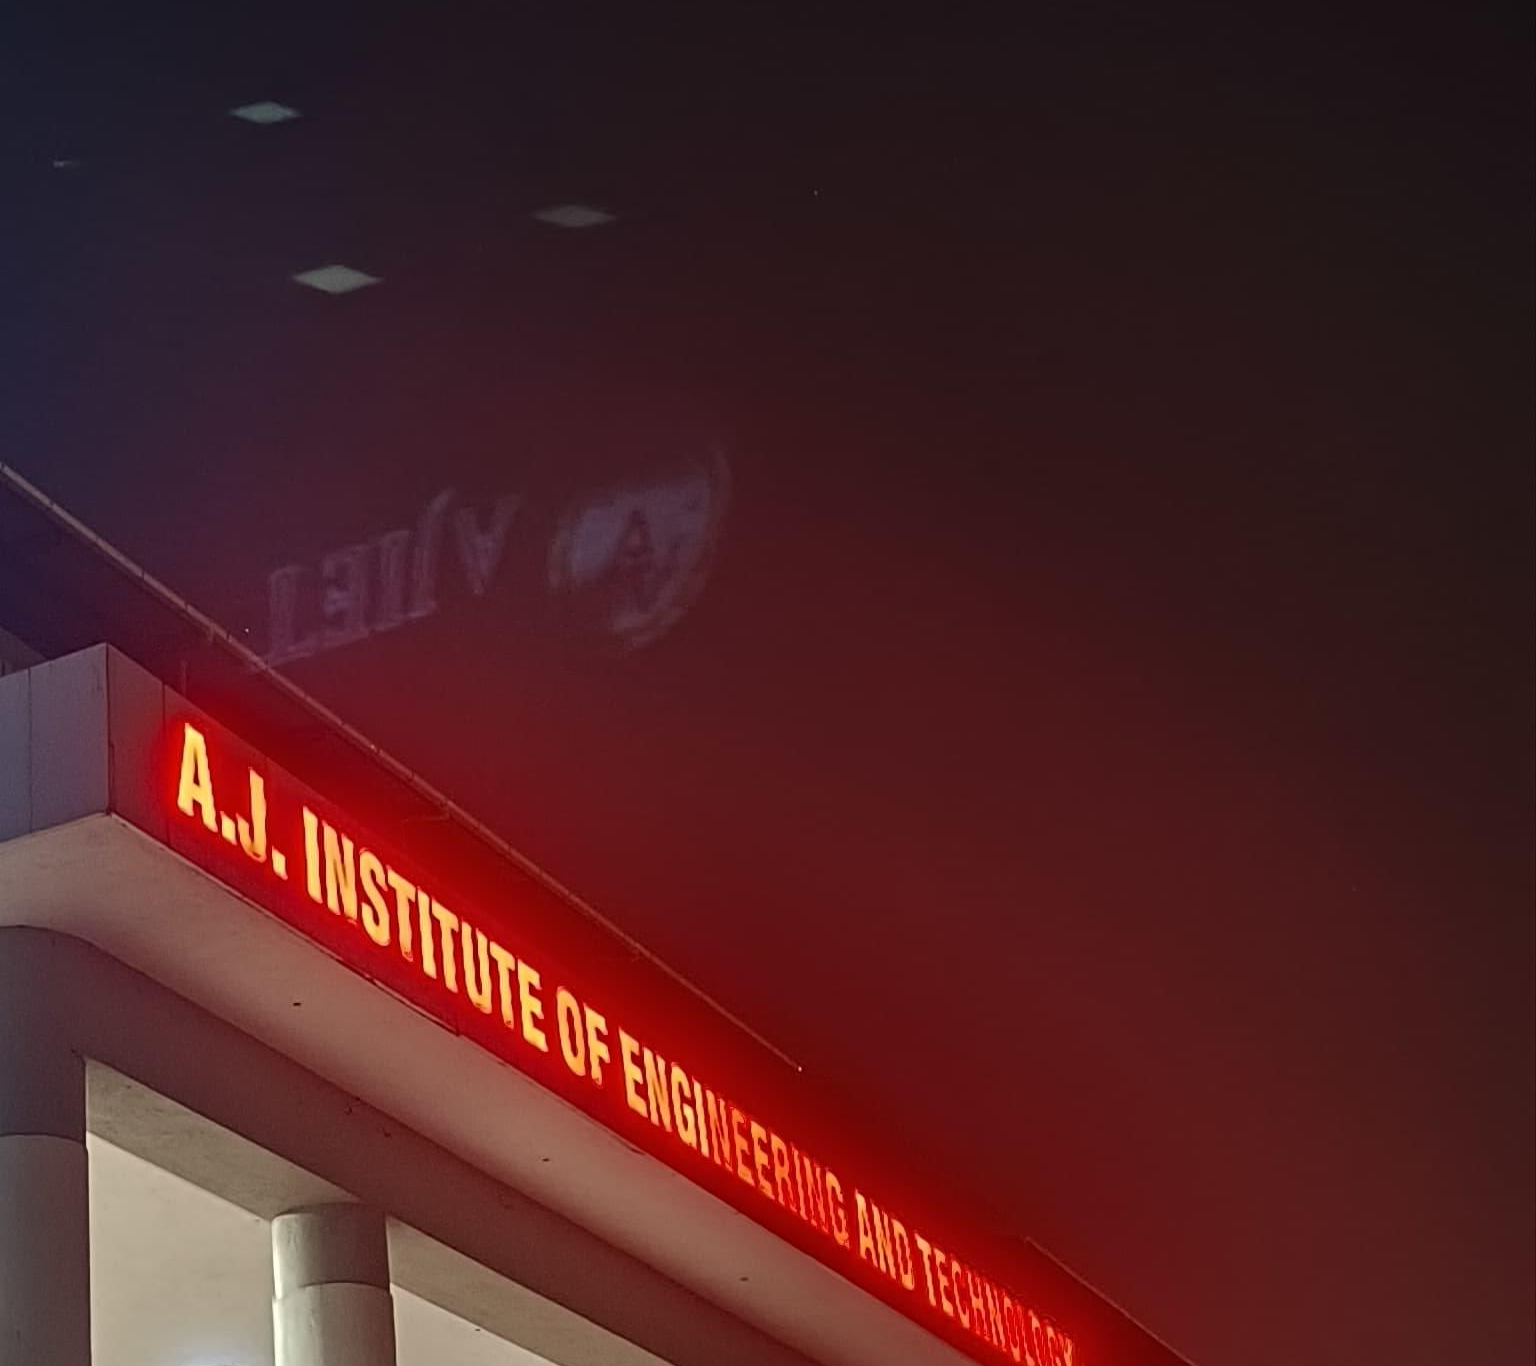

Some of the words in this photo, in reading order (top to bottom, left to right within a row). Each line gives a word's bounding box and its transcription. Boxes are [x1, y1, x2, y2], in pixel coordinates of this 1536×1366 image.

[177, 722, 288, 879] A.J.
[303, 806, 548, 1052] INSTITUTE
[556, 986, 611, 1085] OF
[619, 1028, 850, 1251] ENGINEERING
[855, 1188, 915, 1291] AND
